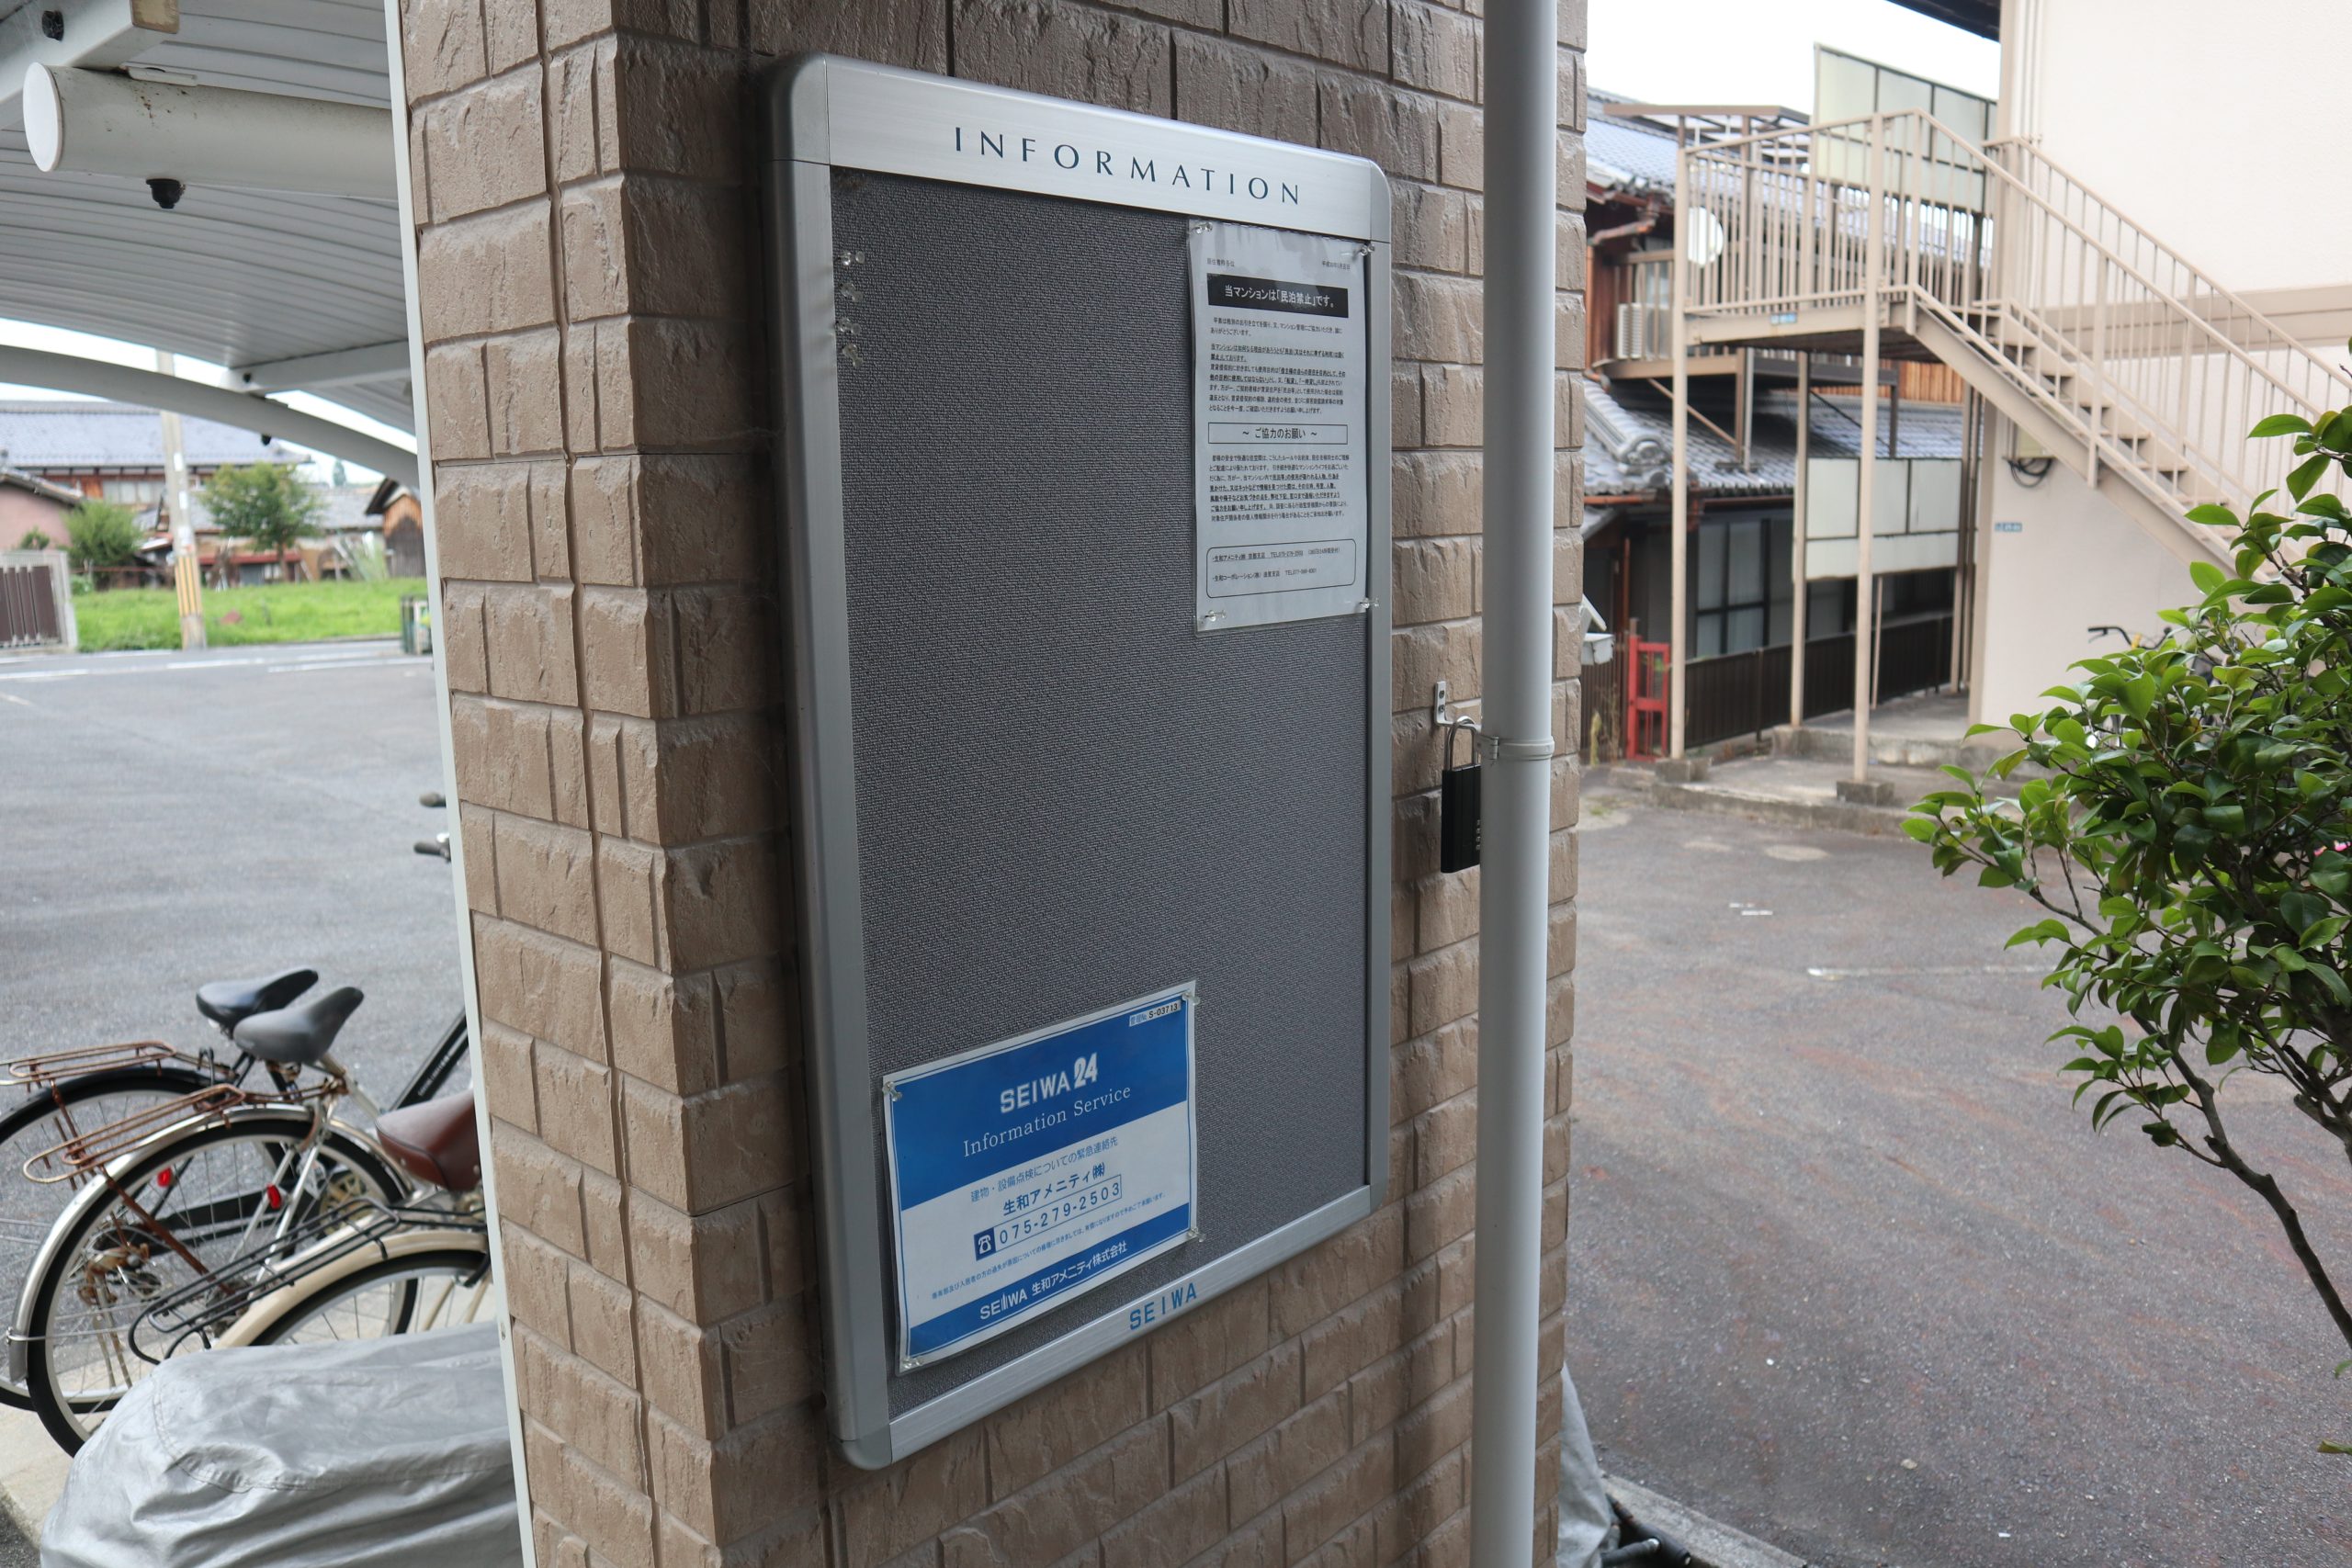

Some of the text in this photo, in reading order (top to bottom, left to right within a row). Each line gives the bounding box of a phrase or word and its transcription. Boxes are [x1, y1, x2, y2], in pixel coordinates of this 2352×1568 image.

[956, 126, 1299, 205] INFORMATION
[1224, 284, 1335, 309] 当マンションは「民泊禁止」です。
[1148, 1002, 1178, 1019] S-03713
[963, 1087, 1131, 1157] Information Service
[970, 1136, 1118, 1202] 建物・設備点検についての緊急連絡先
[999, 1181, 1120, 1245] 075-279-2503
[1031, 1240, 1128, 1297] 生和アメニティ株式会社
[1128, 1282, 1197, 1331] SEIWA
